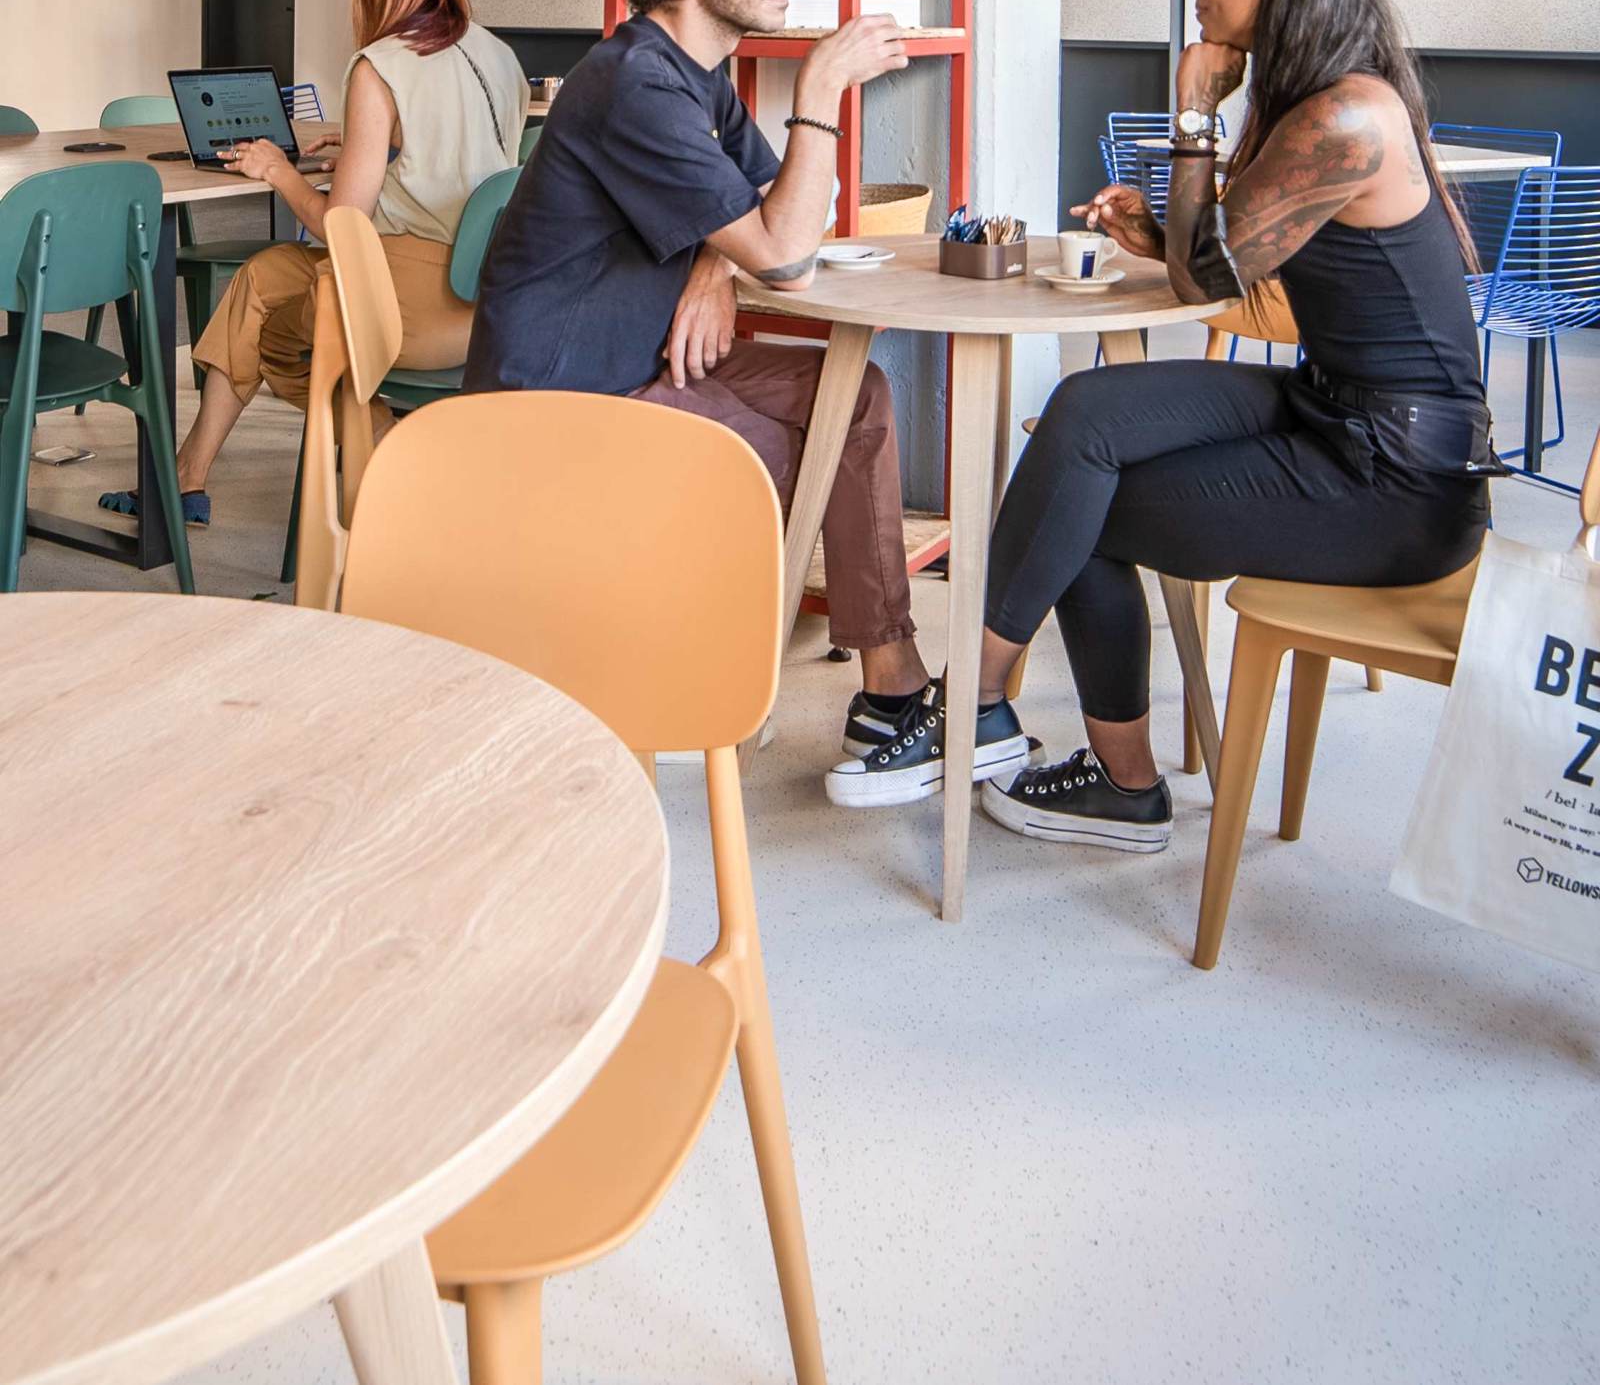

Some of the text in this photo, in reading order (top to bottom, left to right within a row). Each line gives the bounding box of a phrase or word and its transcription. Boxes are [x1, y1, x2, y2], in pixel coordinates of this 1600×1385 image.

[1534, 634, 1600, 713] BE
[1562, 722, 1600, 787] Z
[1554, 792, 1577, 809] bel
[1522, 805, 1548, 821] Milan
[1550, 817, 1567, 829] way
[1514, 822, 1531, 834] way
[1532, 828, 1542, 837] to
[1543, 834, 1558, 844] say
[1546, 871, 1600, 900] YELLOWS
